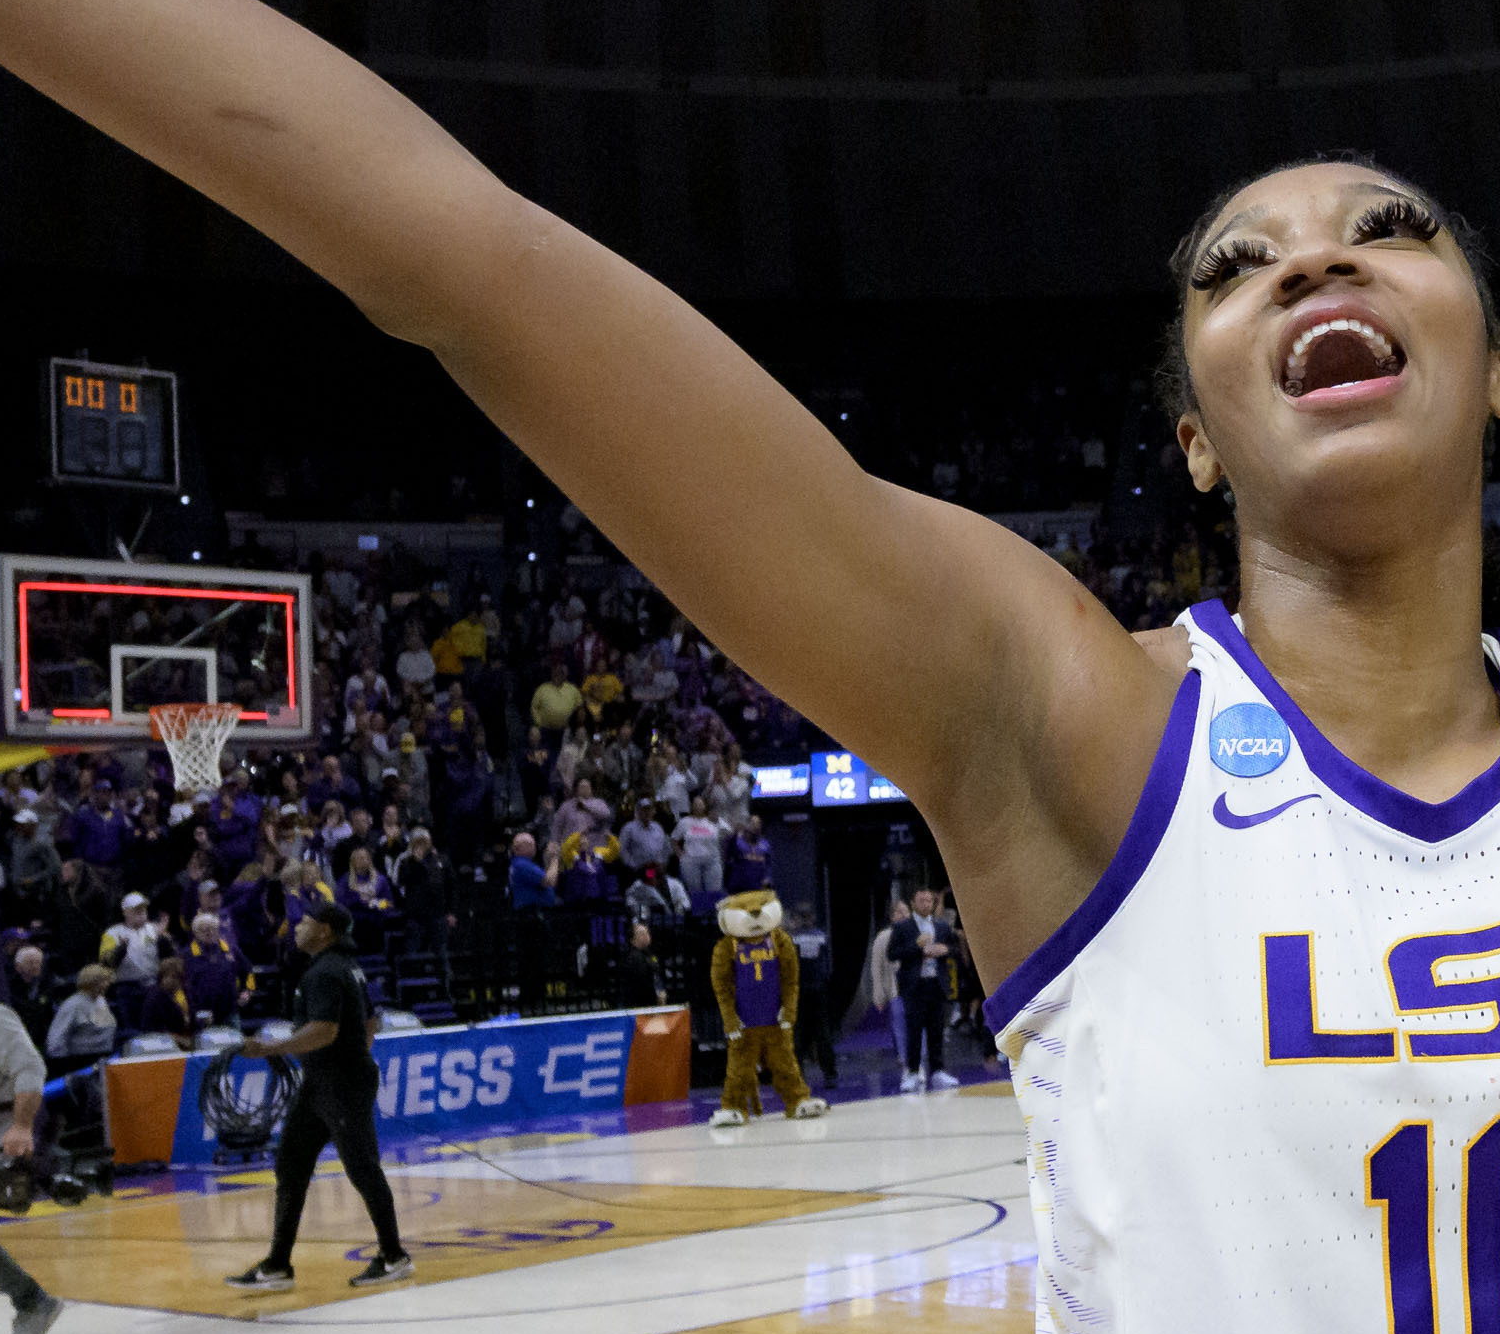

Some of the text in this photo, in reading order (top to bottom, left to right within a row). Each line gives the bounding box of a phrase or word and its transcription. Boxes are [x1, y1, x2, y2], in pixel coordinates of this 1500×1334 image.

[1217, 738, 1284, 757] NCAA
[825, 777, 856, 799] 42
[754, 962, 762, 981] 1
